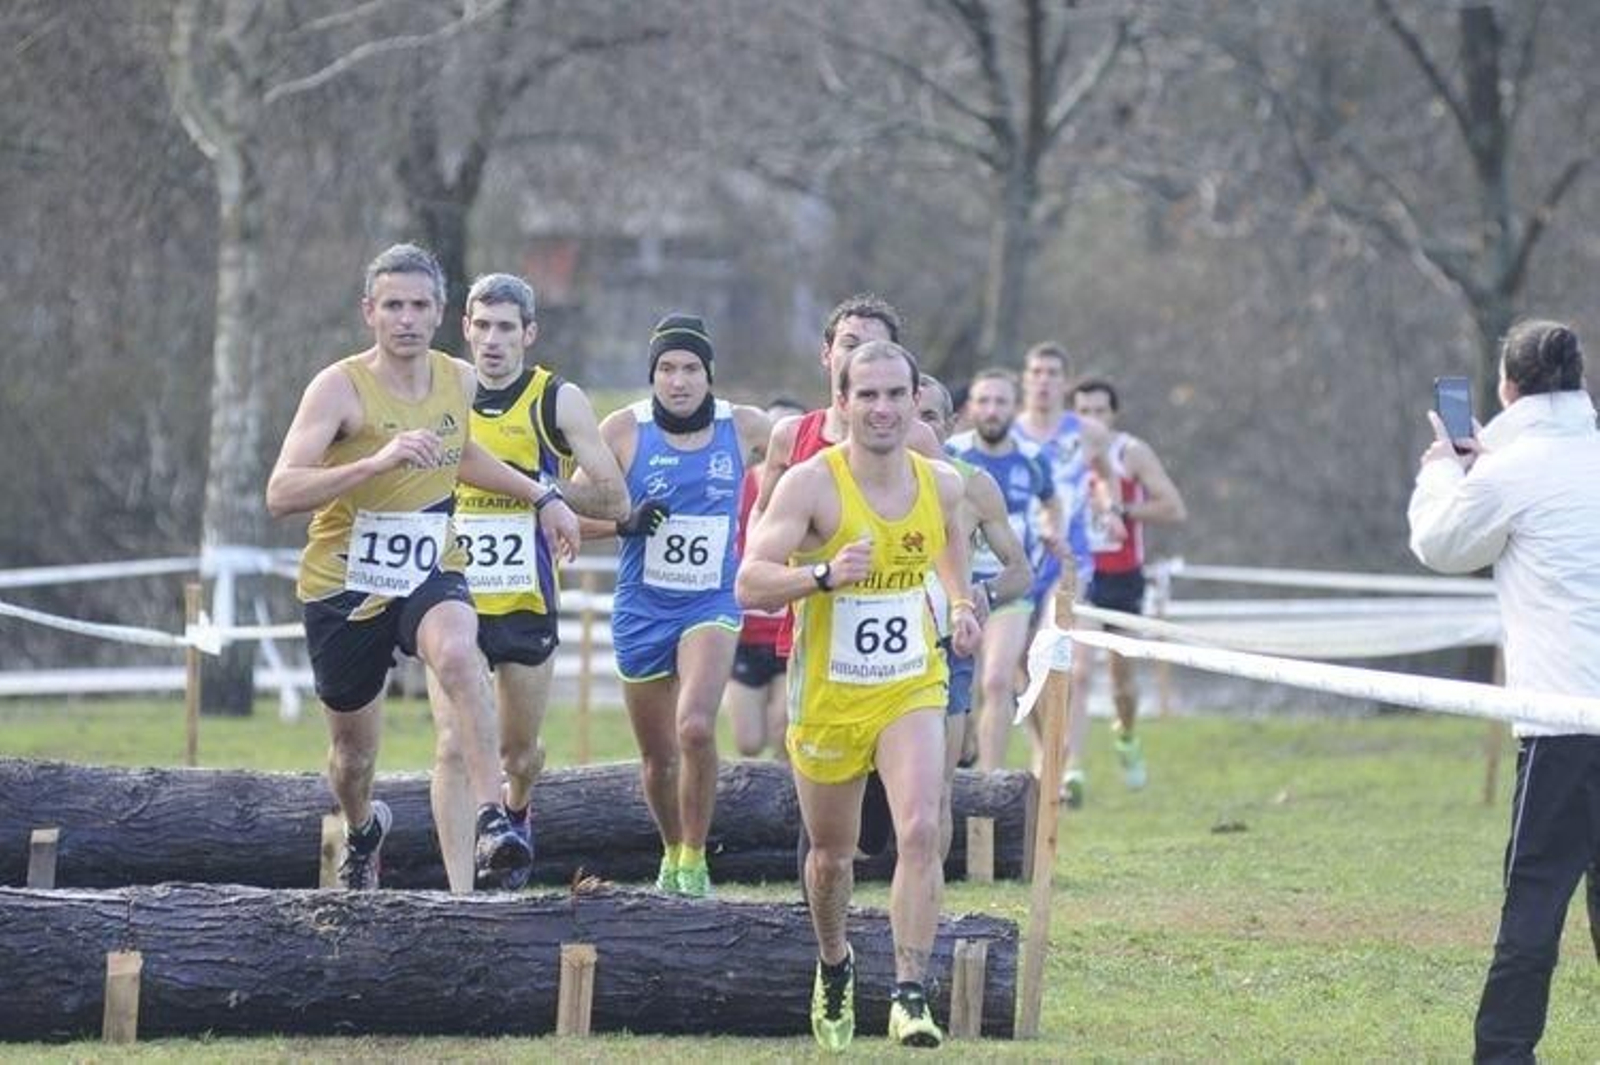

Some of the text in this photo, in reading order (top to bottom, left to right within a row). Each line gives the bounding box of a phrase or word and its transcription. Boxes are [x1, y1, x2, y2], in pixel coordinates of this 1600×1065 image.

[358, 531, 438, 572] 190
[664, 534, 709, 566] 86
[347, 570, 410, 590] RIBADAVIA
[507, 574, 532, 586] 2015
[854, 615, 908, 656] 68
[831, 660, 897, 678] RIBADAVIA
